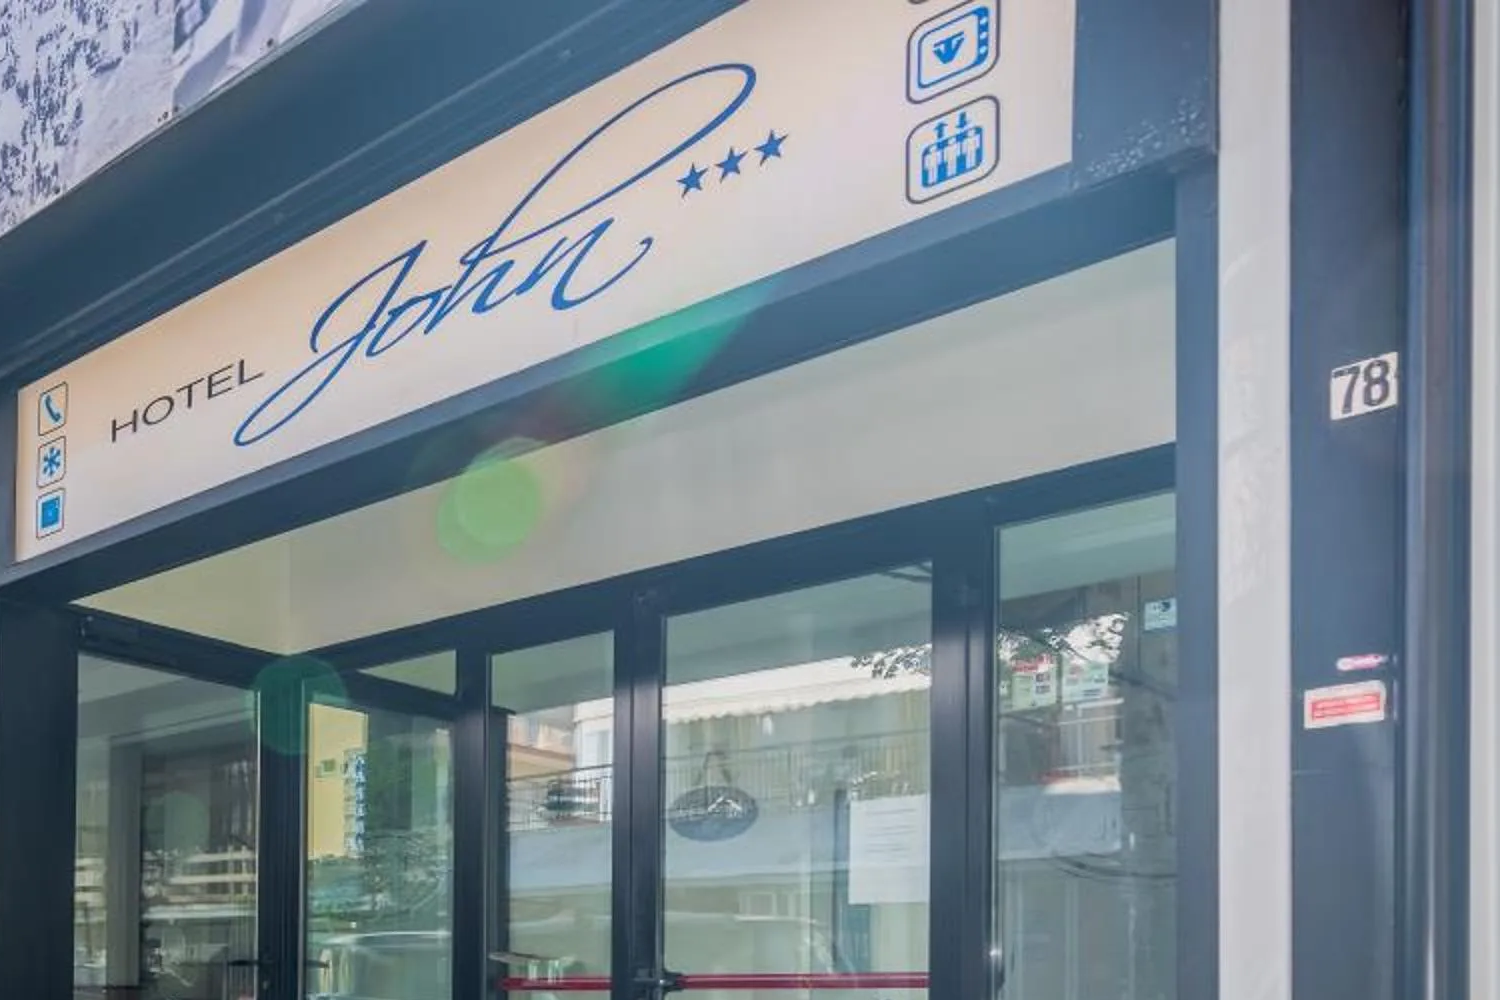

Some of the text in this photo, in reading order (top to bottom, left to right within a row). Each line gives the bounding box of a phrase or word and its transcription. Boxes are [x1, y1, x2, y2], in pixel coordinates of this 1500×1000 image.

[111, 63, 757, 447] HOTEL John
[1334, 359, 1391, 415] 78
